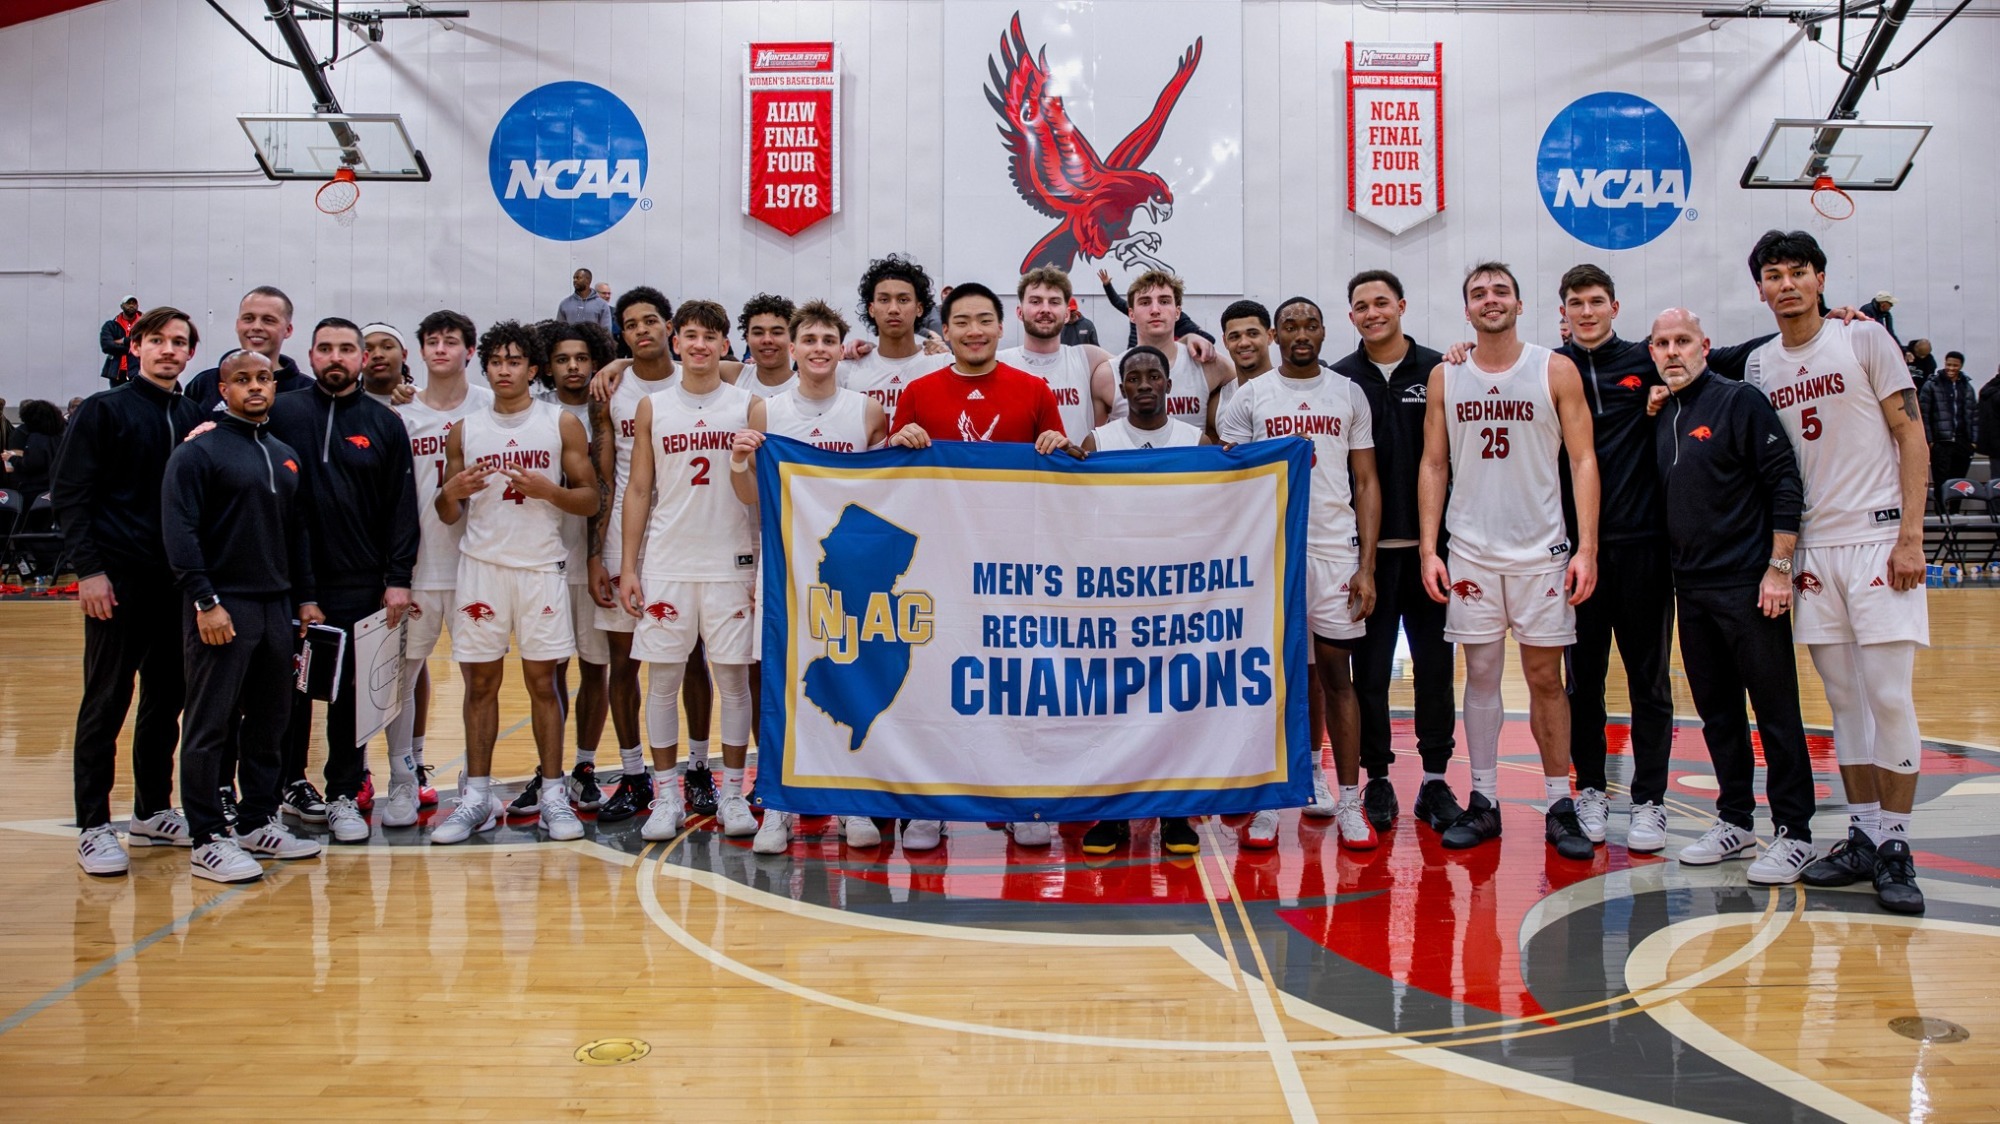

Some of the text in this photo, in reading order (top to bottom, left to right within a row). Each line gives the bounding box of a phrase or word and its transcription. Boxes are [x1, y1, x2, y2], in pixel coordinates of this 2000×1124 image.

[749, 76, 834, 86] WOMEN'S BASKETBALL
[1352, 75, 1437, 85] WOMEN'S BASKETBALL
[766, 102, 817, 123] AIAW
[1371, 101, 1420, 121] NCAA
[764, 127, 818, 147] FINAL
[1369, 126, 1422, 146] FINAL
[767, 152, 815, 172] FOUR
[1372, 151, 1420, 171] FOUR
[504, 159, 642, 199] NCAA
[1553, 168, 1686, 209] NCAA
[765, 184, 818, 208] 1978
[1371, 183, 1422, 206] 2015
[1052, 388, 1080, 406] WKS
[1167, 397, 1200, 415] AWKS
[621, 419, 635, 437] RE
[1801, 406, 1823, 441] 5
[1480, 427, 1510, 459] 25
[689, 457, 711, 486] 2
[973, 555, 1254, 598] MEN'S BASKETBALL
[809, 586, 933, 665] NJAC
[983, 607, 1243, 649] REGULAR SEASON
[951, 646, 1272, 717] CHAMPIONS
